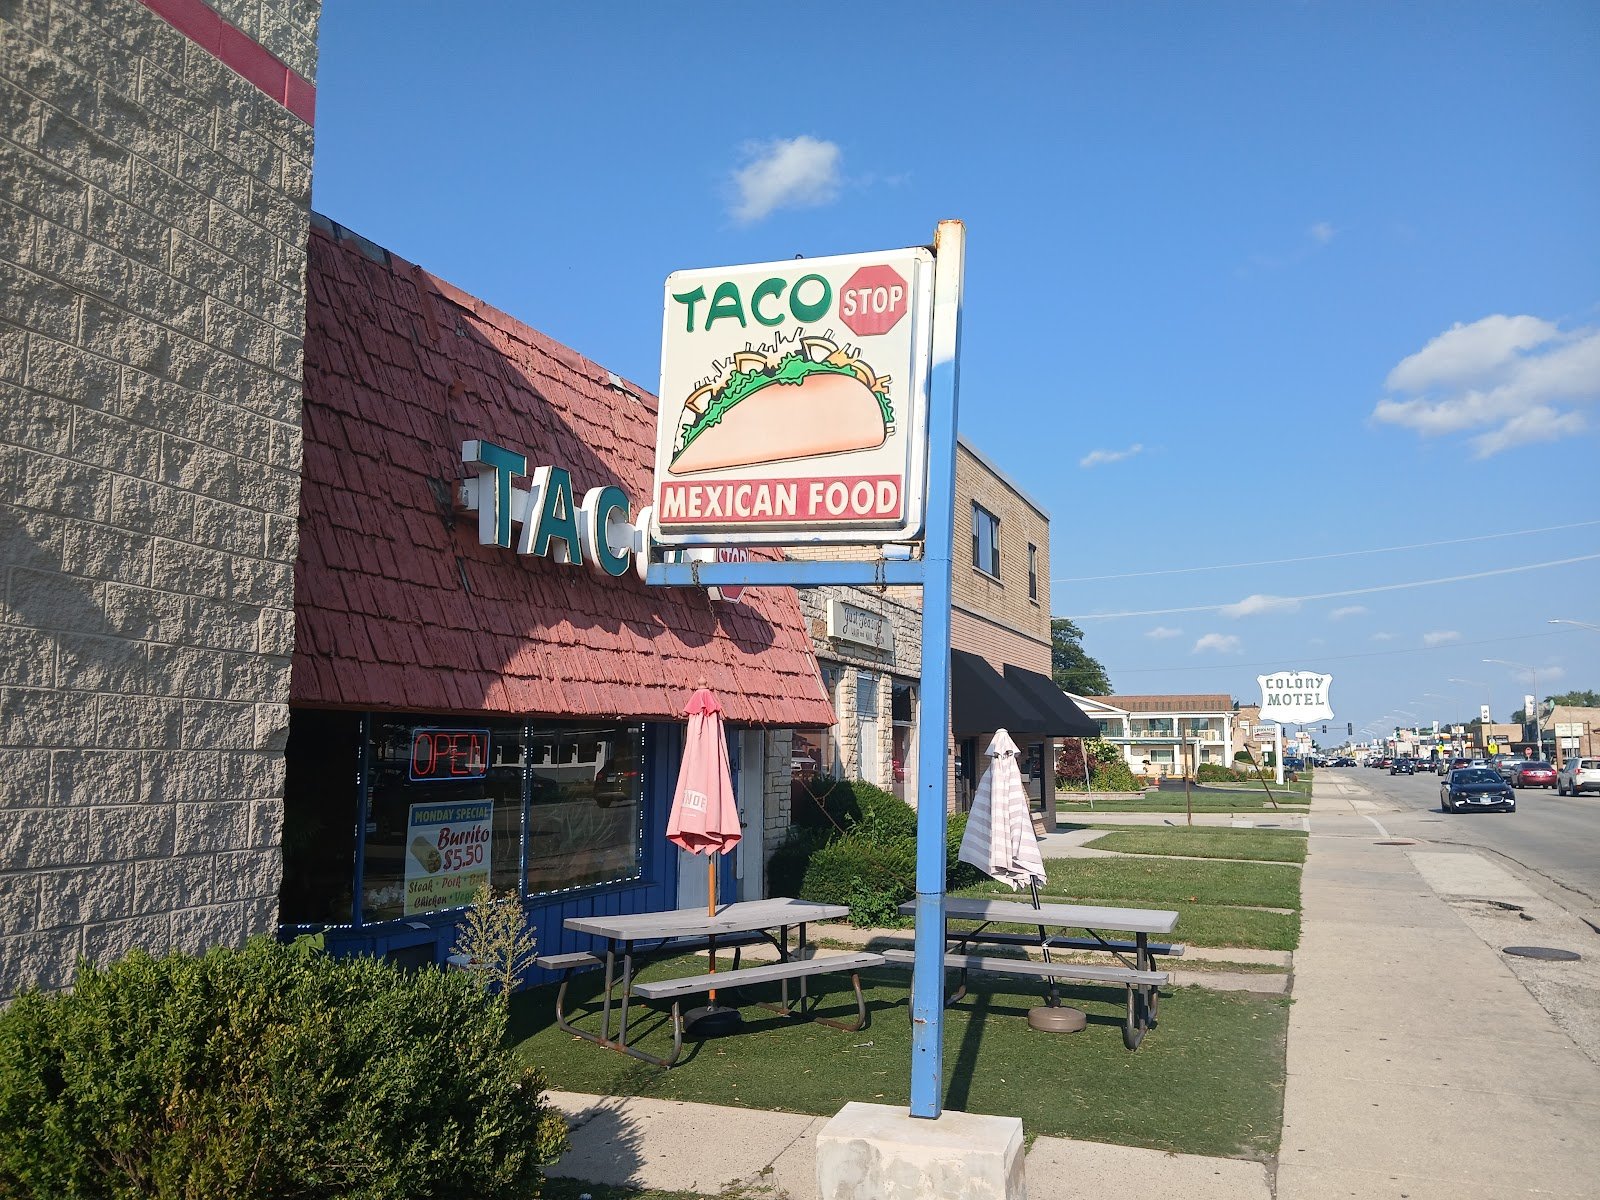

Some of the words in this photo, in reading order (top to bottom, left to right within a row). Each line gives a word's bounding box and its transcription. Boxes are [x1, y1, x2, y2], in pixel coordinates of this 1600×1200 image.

[672, 273, 833, 333] TACO
[843, 286, 904, 316] STOP
[463, 439, 683, 578] TAC
[661, 483, 798, 519] MEXICAN
[808, 480, 898, 516] FOOD
[1266, 677, 1324, 689] COLONY
[1267, 693, 1325, 706] MOTEL
[413, 733, 488, 776] OPEN
[415, 809, 454, 823] MONDAY
[456, 806, 489, 820] SPECIAL
[437, 824, 490, 850] Burrito
[443, 844, 483, 872] $5.50
[408, 879, 433, 894] Steak
[441, 875, 461, 889] Pork
[414, 895, 447, 908] Chicken
